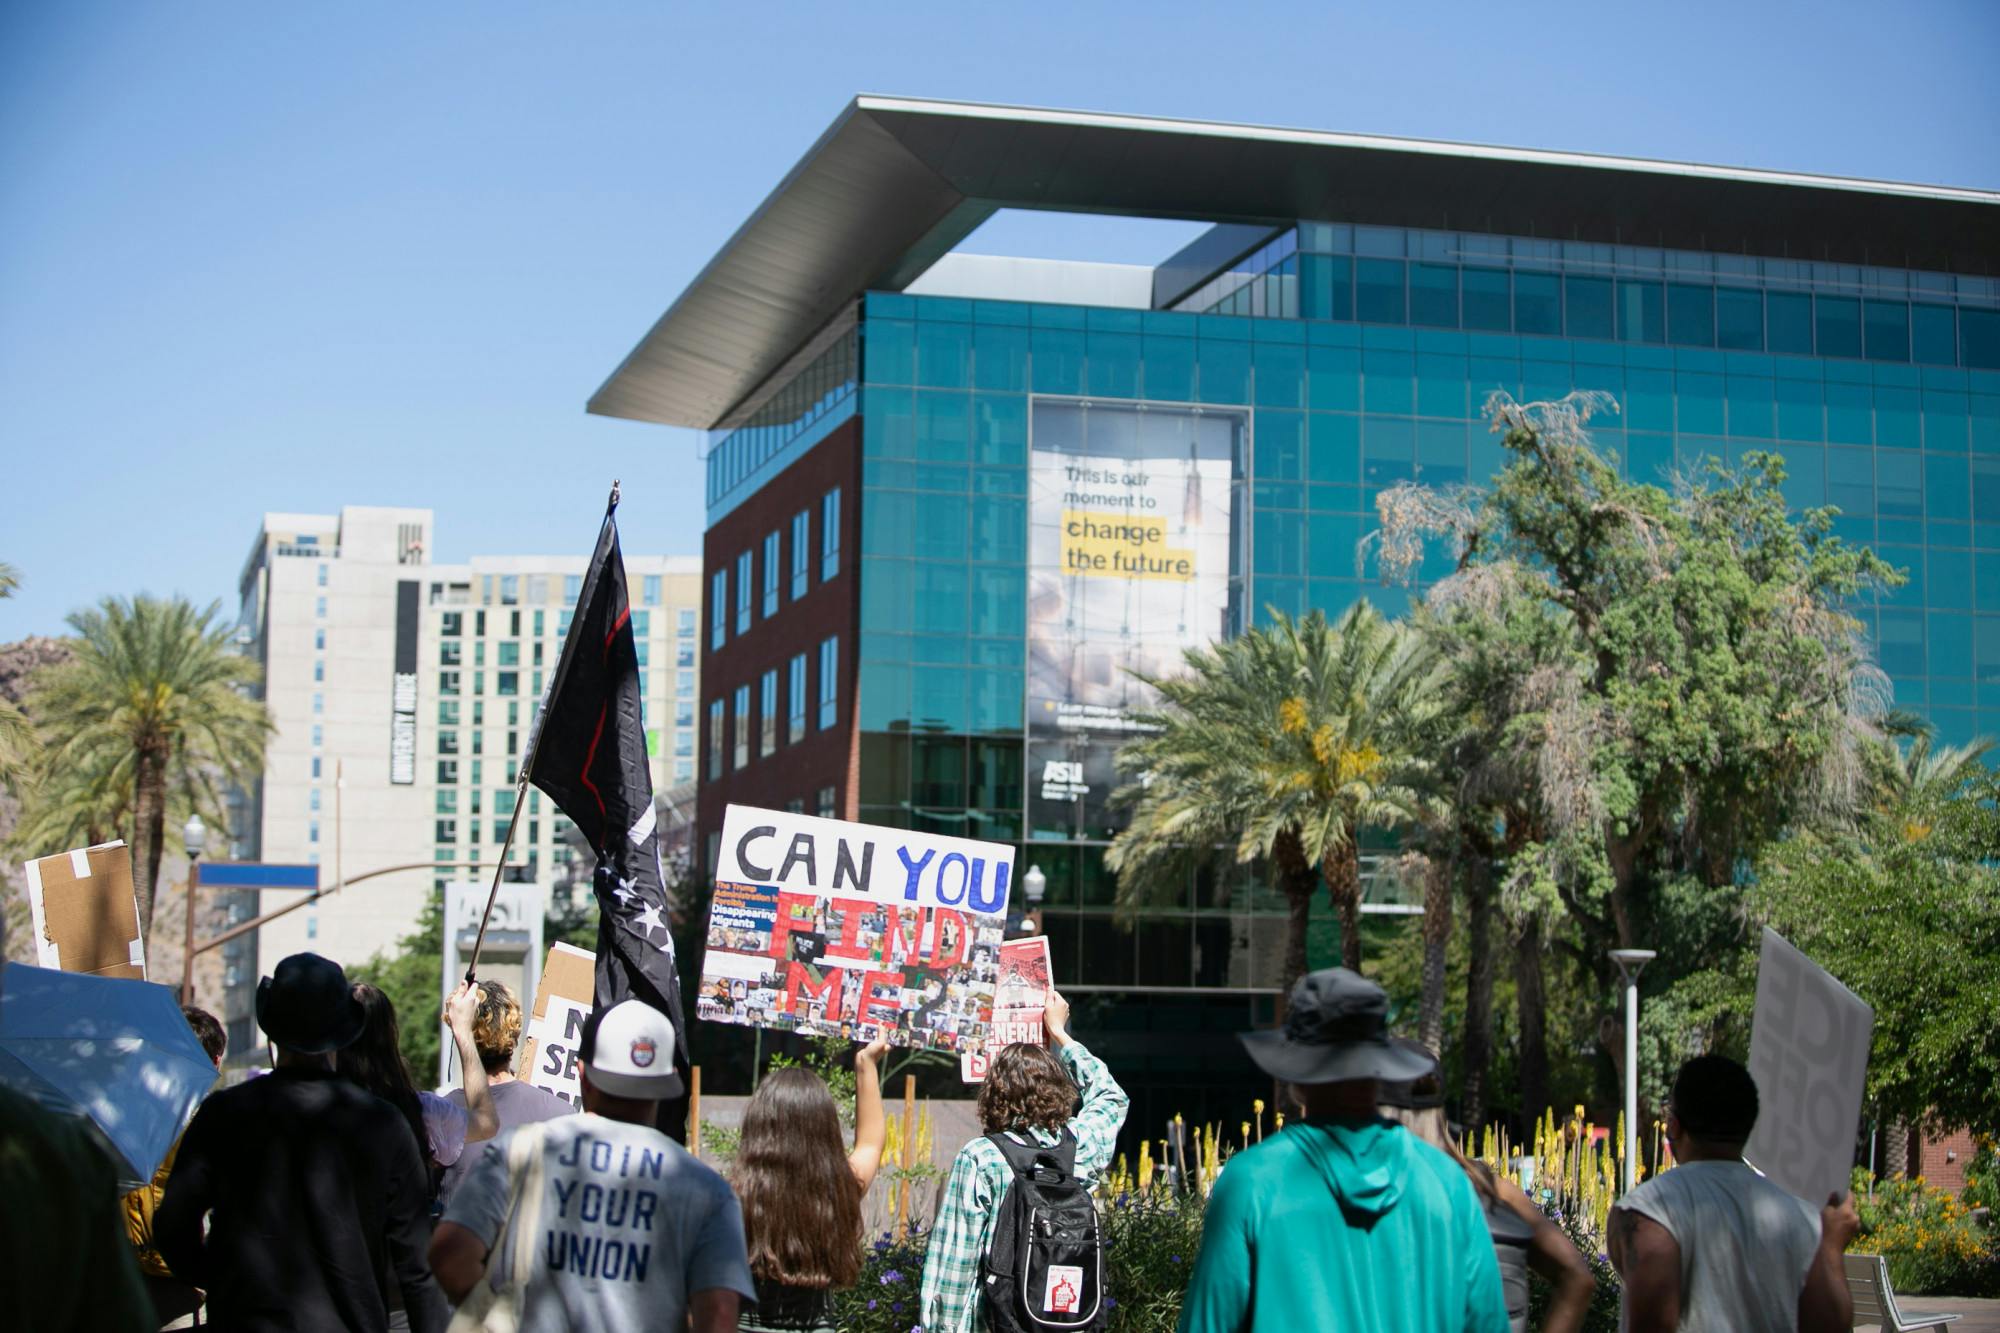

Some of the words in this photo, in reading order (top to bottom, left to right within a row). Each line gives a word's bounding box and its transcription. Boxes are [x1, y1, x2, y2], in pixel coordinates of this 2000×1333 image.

[1065, 466, 1100, 484] This
[1104, 469, 1118, 485] is
[1121, 473, 1150, 486] our
[1064, 491, 1134, 507] moment
[1139, 495, 1157, 509] to
[1067, 517, 1161, 546] change
[1067, 547, 1107, 570] the
[736, 826, 875, 891] CAN
[897, 845, 1010, 914] YOU
[710, 914, 756, 929] Migrants
[711, 904, 777, 922] Disappearing
[769, 891, 967, 969] FIND
[559, 1133, 664, 1179] JOIN
[553, 1178, 658, 1231] YOUR
[547, 1230, 651, 1283] UNION
